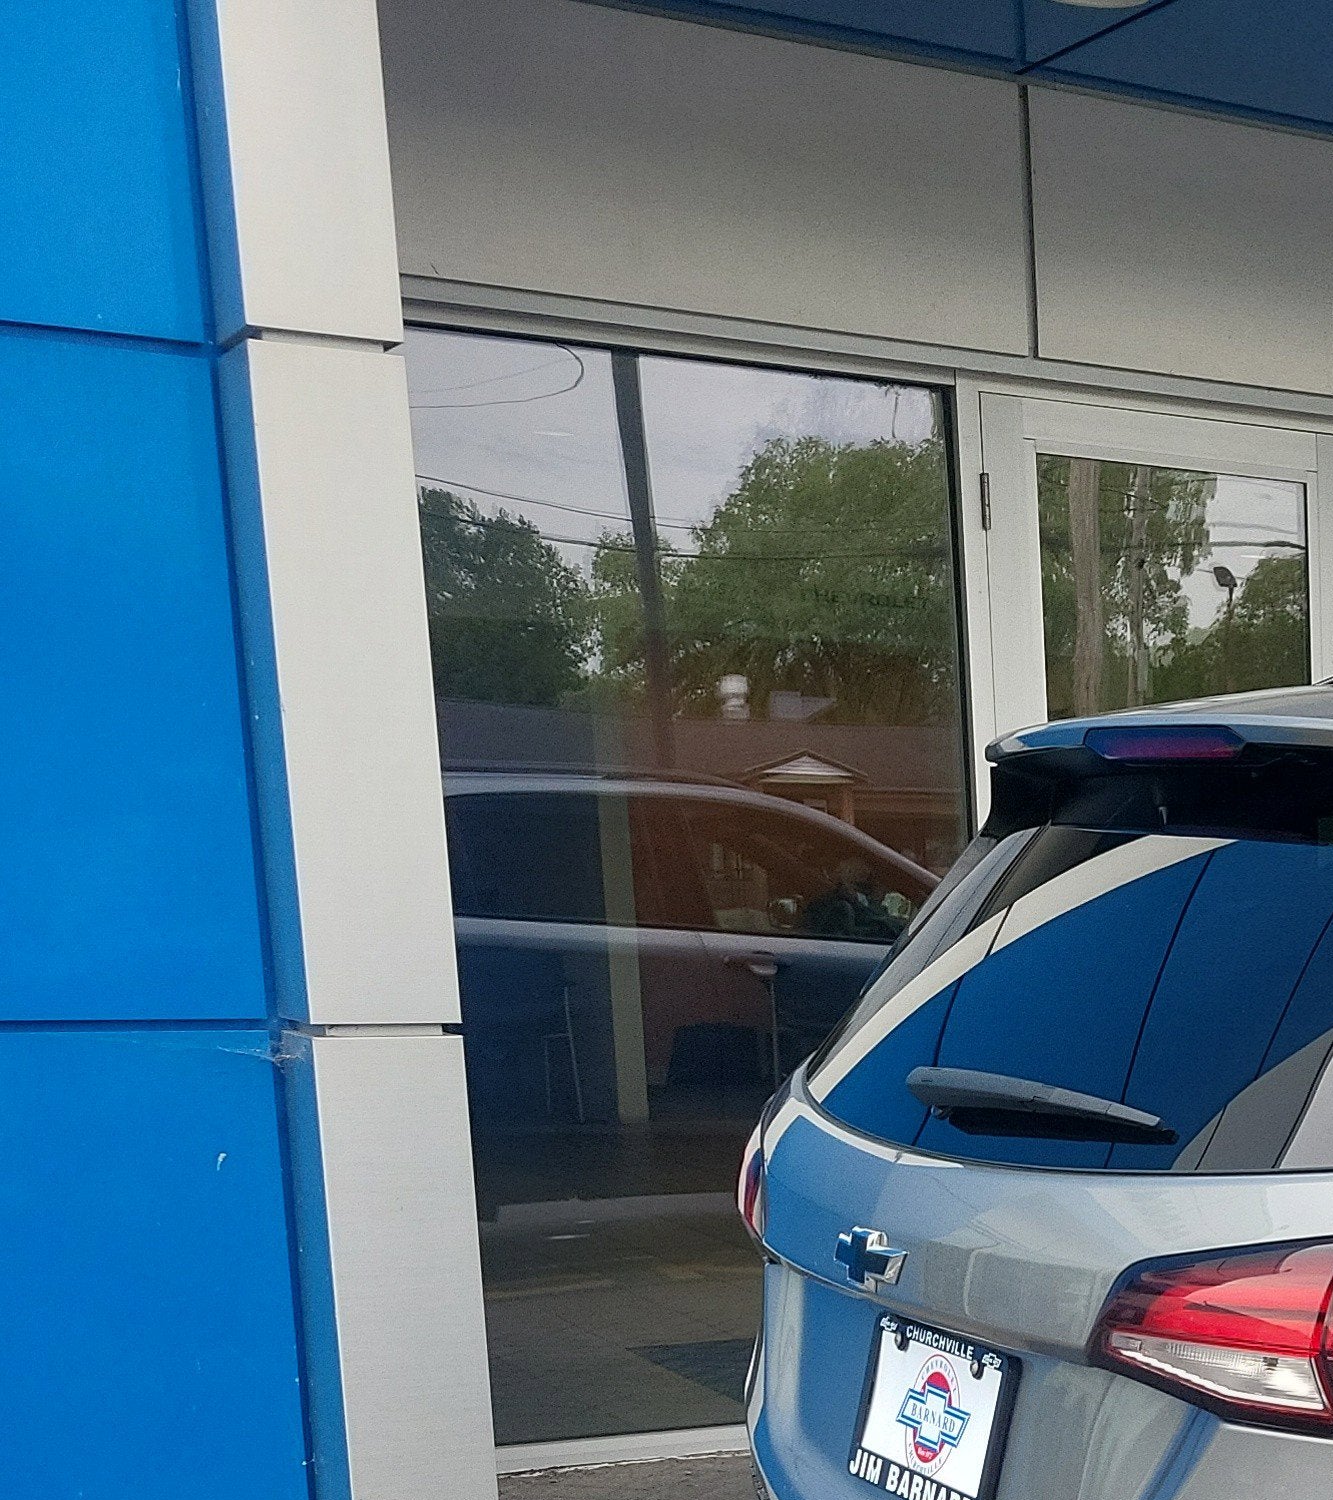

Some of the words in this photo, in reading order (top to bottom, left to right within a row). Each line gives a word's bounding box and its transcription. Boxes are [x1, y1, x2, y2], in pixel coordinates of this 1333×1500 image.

[906, 1325, 974, 1360] CHURCHVILLE
[911, 1403, 956, 1433] BARNARD
[849, 1448, 882, 1486] JIM
